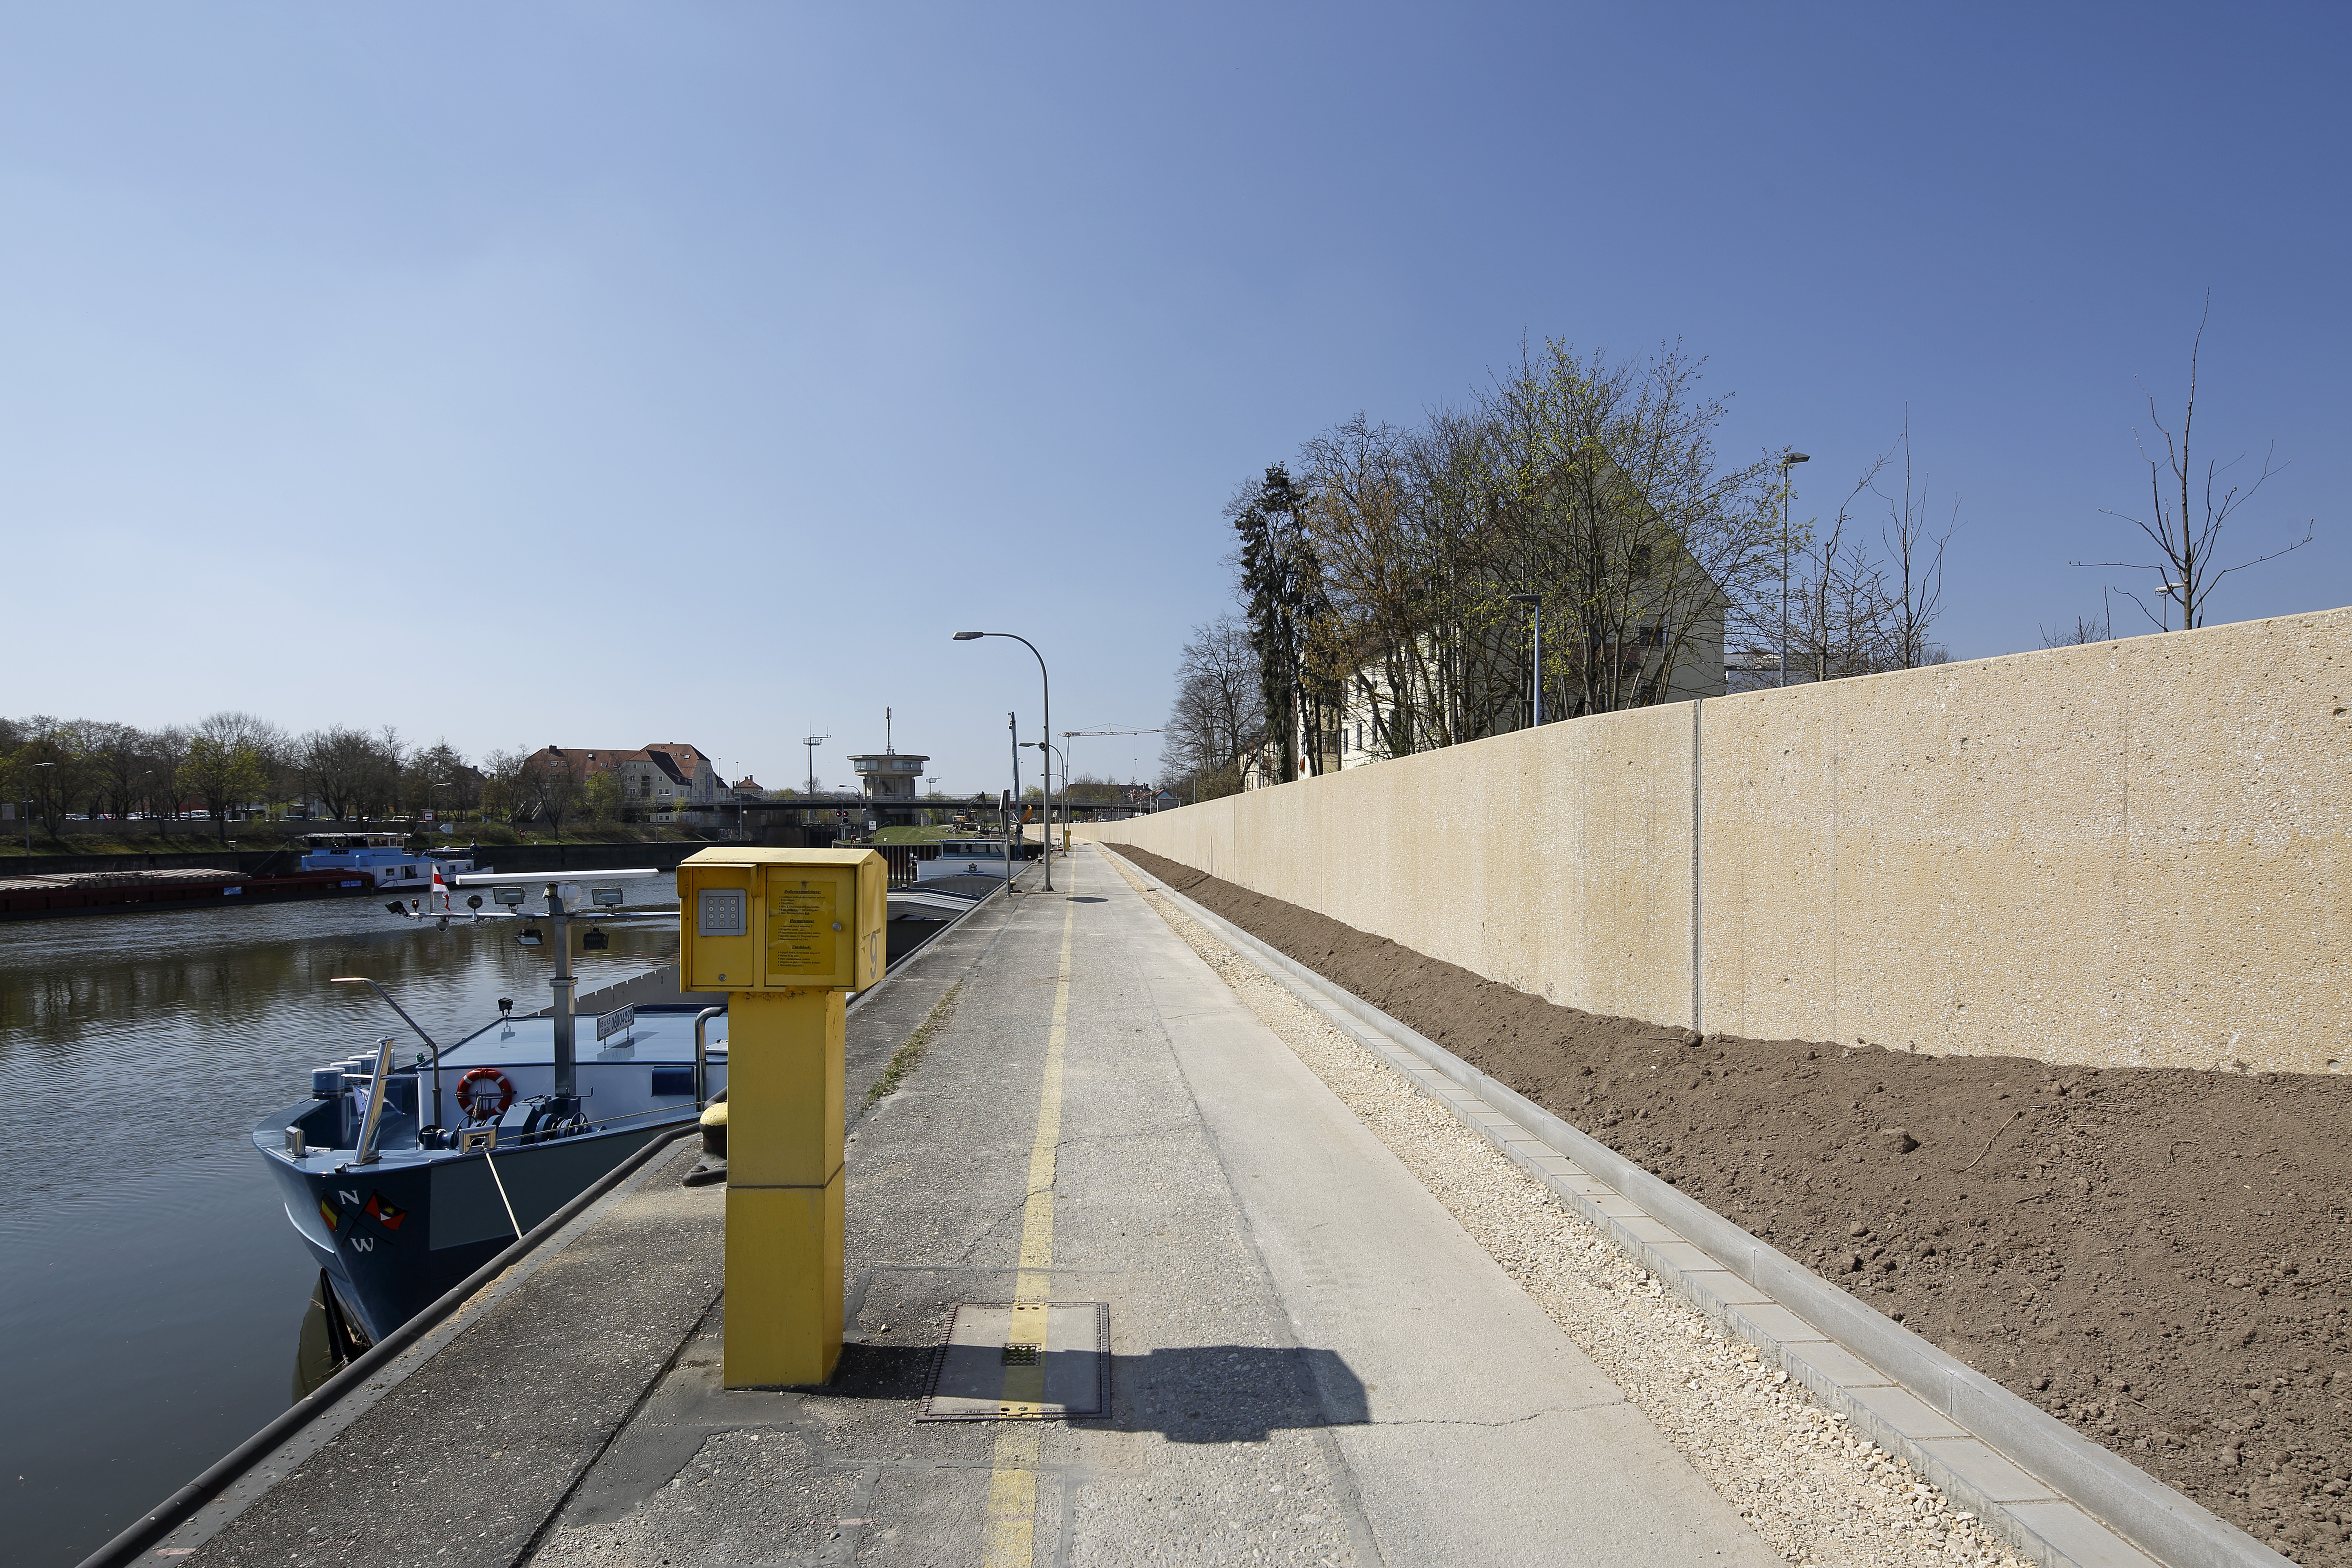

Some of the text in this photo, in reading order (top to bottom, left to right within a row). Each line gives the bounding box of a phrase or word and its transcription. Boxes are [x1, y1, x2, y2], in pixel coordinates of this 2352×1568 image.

[870, 930, 878, 980] 9
[661, 976, 664, 984] 2
[611, 1009, 633, 1030] 06004228
[339, 1190, 360, 1204] N
[350, 1238, 373, 1252] W
